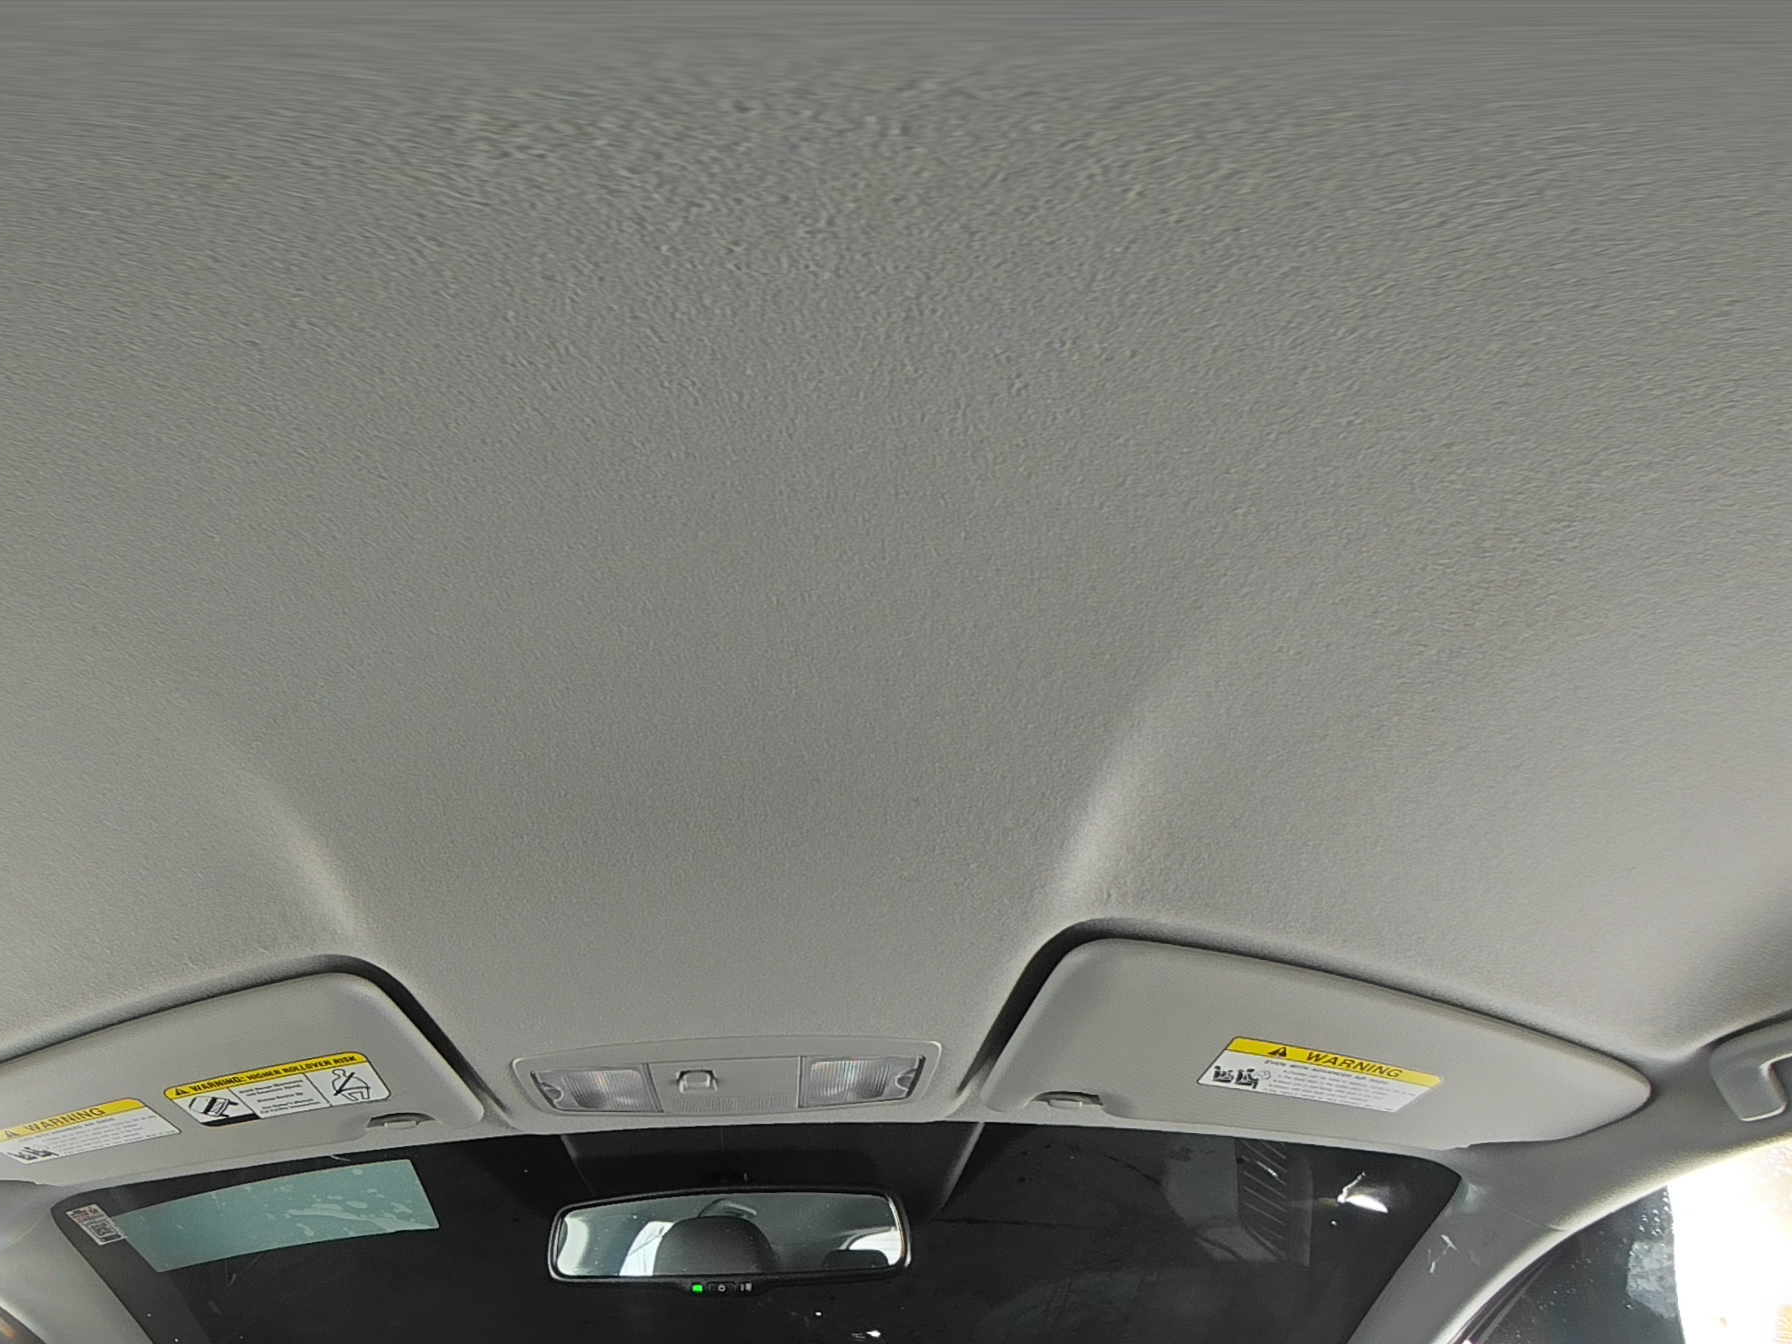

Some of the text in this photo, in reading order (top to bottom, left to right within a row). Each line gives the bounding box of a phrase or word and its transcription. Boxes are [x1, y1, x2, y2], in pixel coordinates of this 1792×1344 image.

[189, 1076, 245, 1094] WARNING:
[247, 1068, 281, 1083] HIGHER
[282, 1059, 331, 1076] ROLLOVER
[333, 1055, 357, 1067] RISK
[1306, 1051, 1403, 1079] WARNING
[22, 1107, 106, 1132] WARNING
